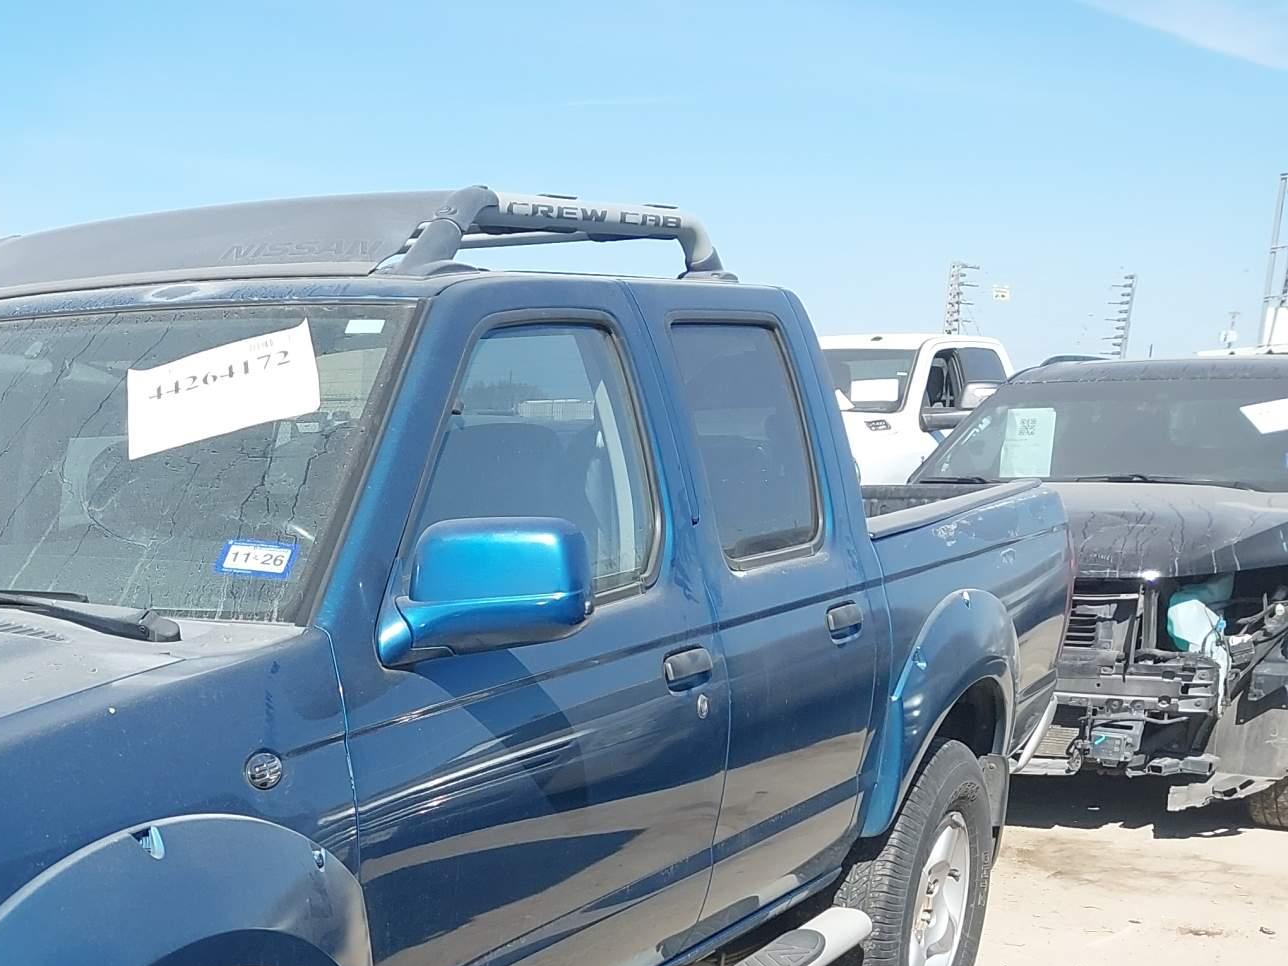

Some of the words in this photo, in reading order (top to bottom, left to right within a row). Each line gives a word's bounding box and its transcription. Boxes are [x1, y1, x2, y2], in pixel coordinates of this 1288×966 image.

[506, 201, 608, 223] CREW
[620, 211, 682, 229] CAB
[217, 239, 385, 265] NISSAN
[148, 350, 291, 400] 44264172
[231, 551, 251, 563] 11
[261, 553, 285, 567] 26
